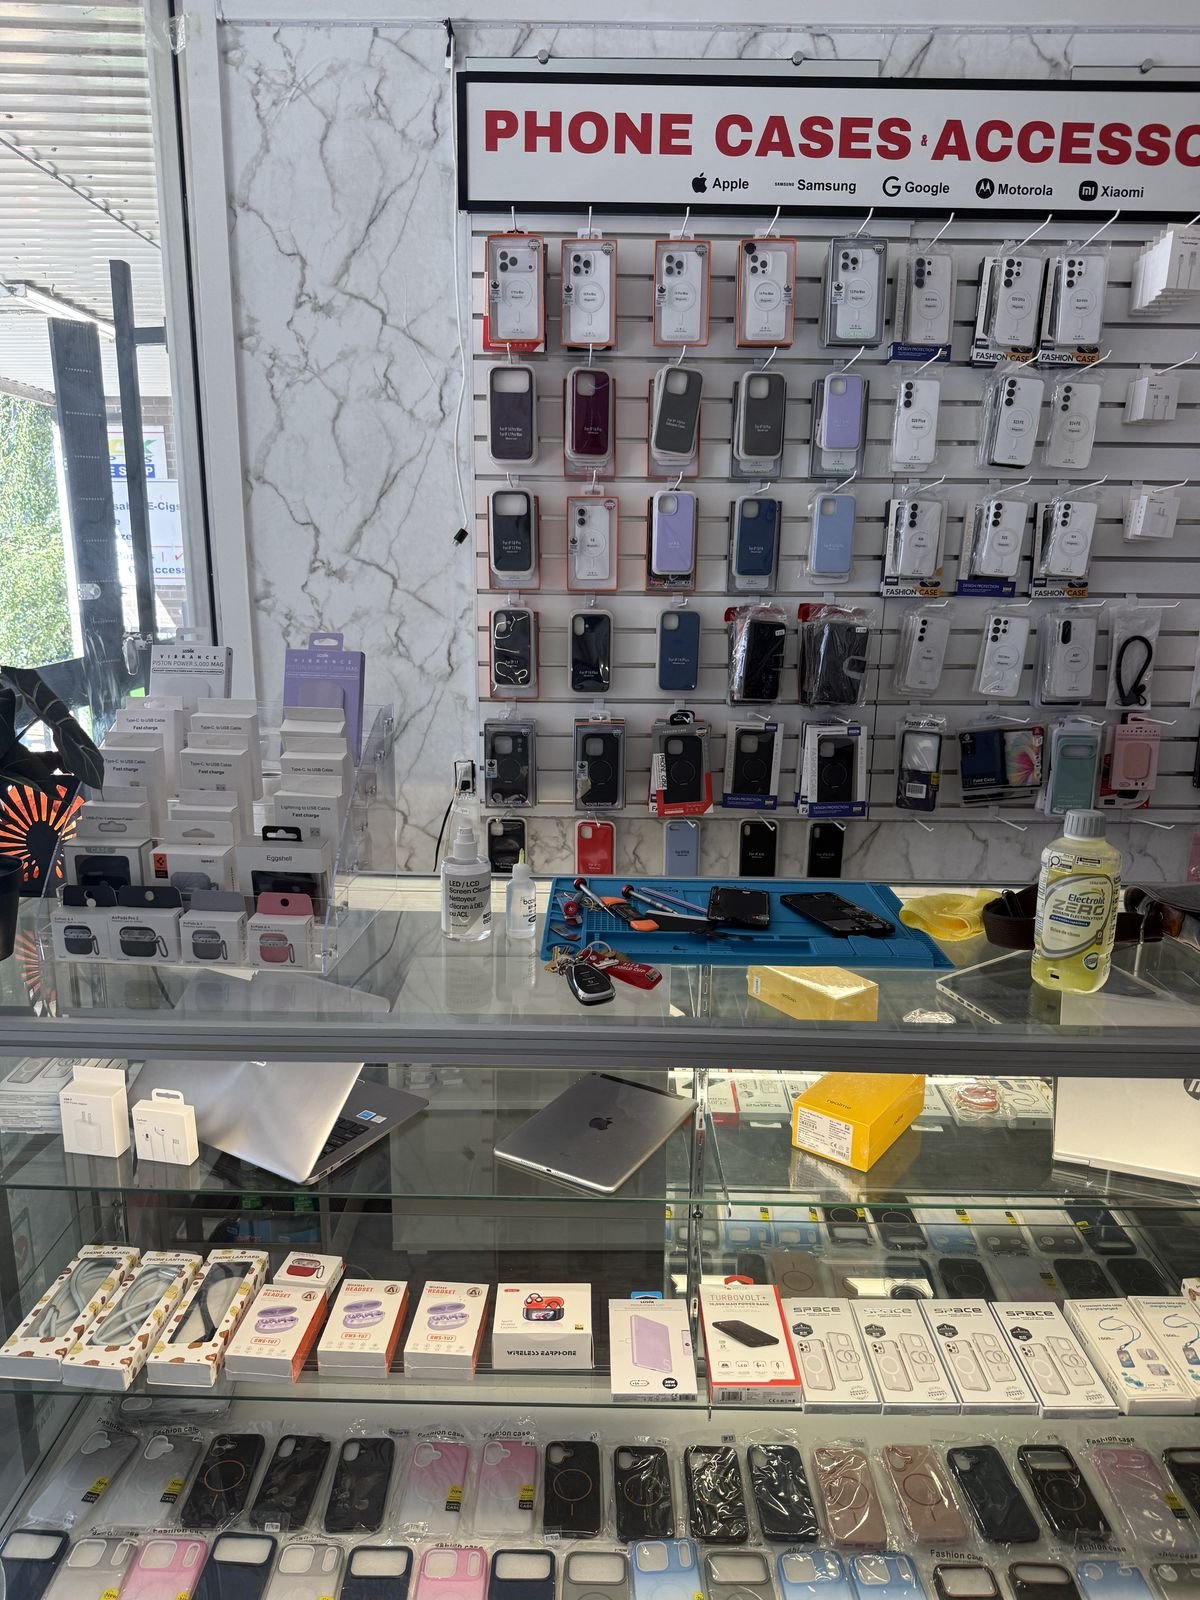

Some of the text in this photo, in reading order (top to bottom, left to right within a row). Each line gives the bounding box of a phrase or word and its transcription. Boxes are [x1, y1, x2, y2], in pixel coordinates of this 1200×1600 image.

[485, 109, 1200, 168] PHONE CASES & ACCESSO
[712, 177, 749, 190] Apple
[797, 178, 857, 195] Samsung
[904, 181, 950, 196] Google
[998, 183, 1053, 197] Motorola
[1100, 185, 1144, 198] Xiaomi
[975, 352, 1030, 363] FASHION CASE
[1041, 353, 1096, 363] FASHION CASE
[886, 588, 939, 597] FASHION CASE
[1034, 589, 1087, 598] FASHION CASE
[266, 855, 293, 863] Eggshell
[1053, 899, 1104, 916] ZERO
[826, 1099, 852, 1110] realme
[153, 1426, 182, 1435] Fashion
[1087, 1436, 1117, 1445] Fashion
[930, 1549, 965, 1559] Fashion
